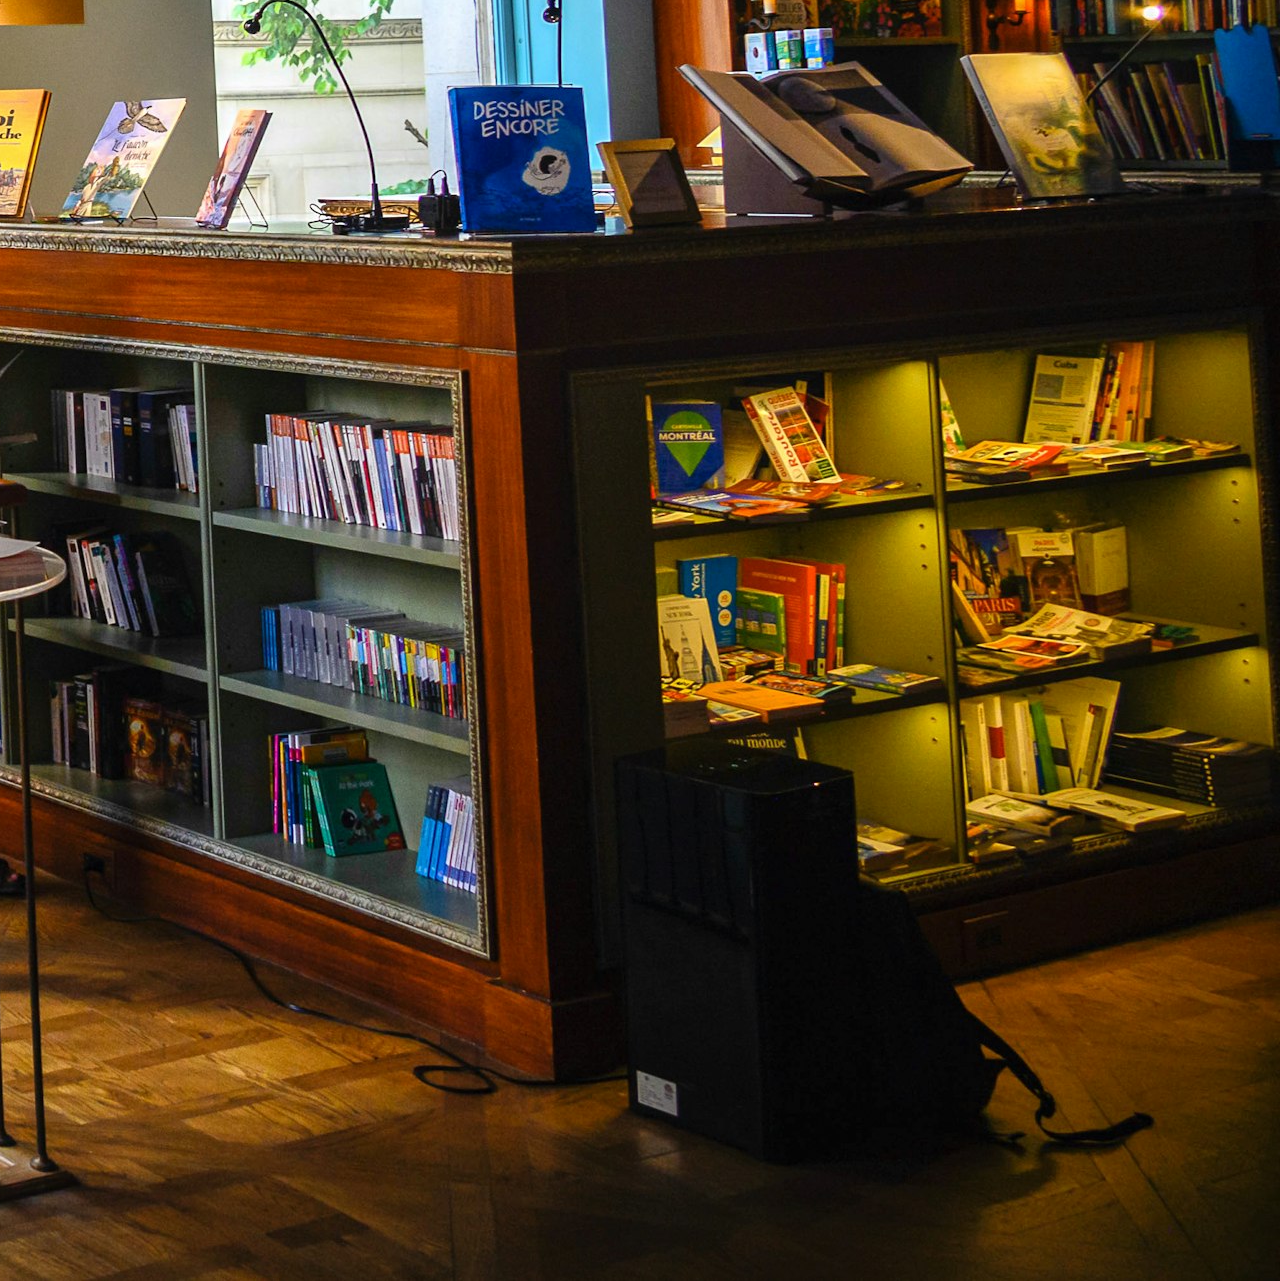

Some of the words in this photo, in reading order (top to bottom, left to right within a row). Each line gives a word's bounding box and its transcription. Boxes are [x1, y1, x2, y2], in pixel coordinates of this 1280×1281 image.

[481, 118, 559, 139] ENCORE
[1053, 359, 1079, 369] Cuba
[767, 391, 797, 405] QUÉBEC
[658, 430, 716, 441] MONTRÉAL
[691, 563, 702, 592] York
[973, 598, 1017, 613] PARIS
